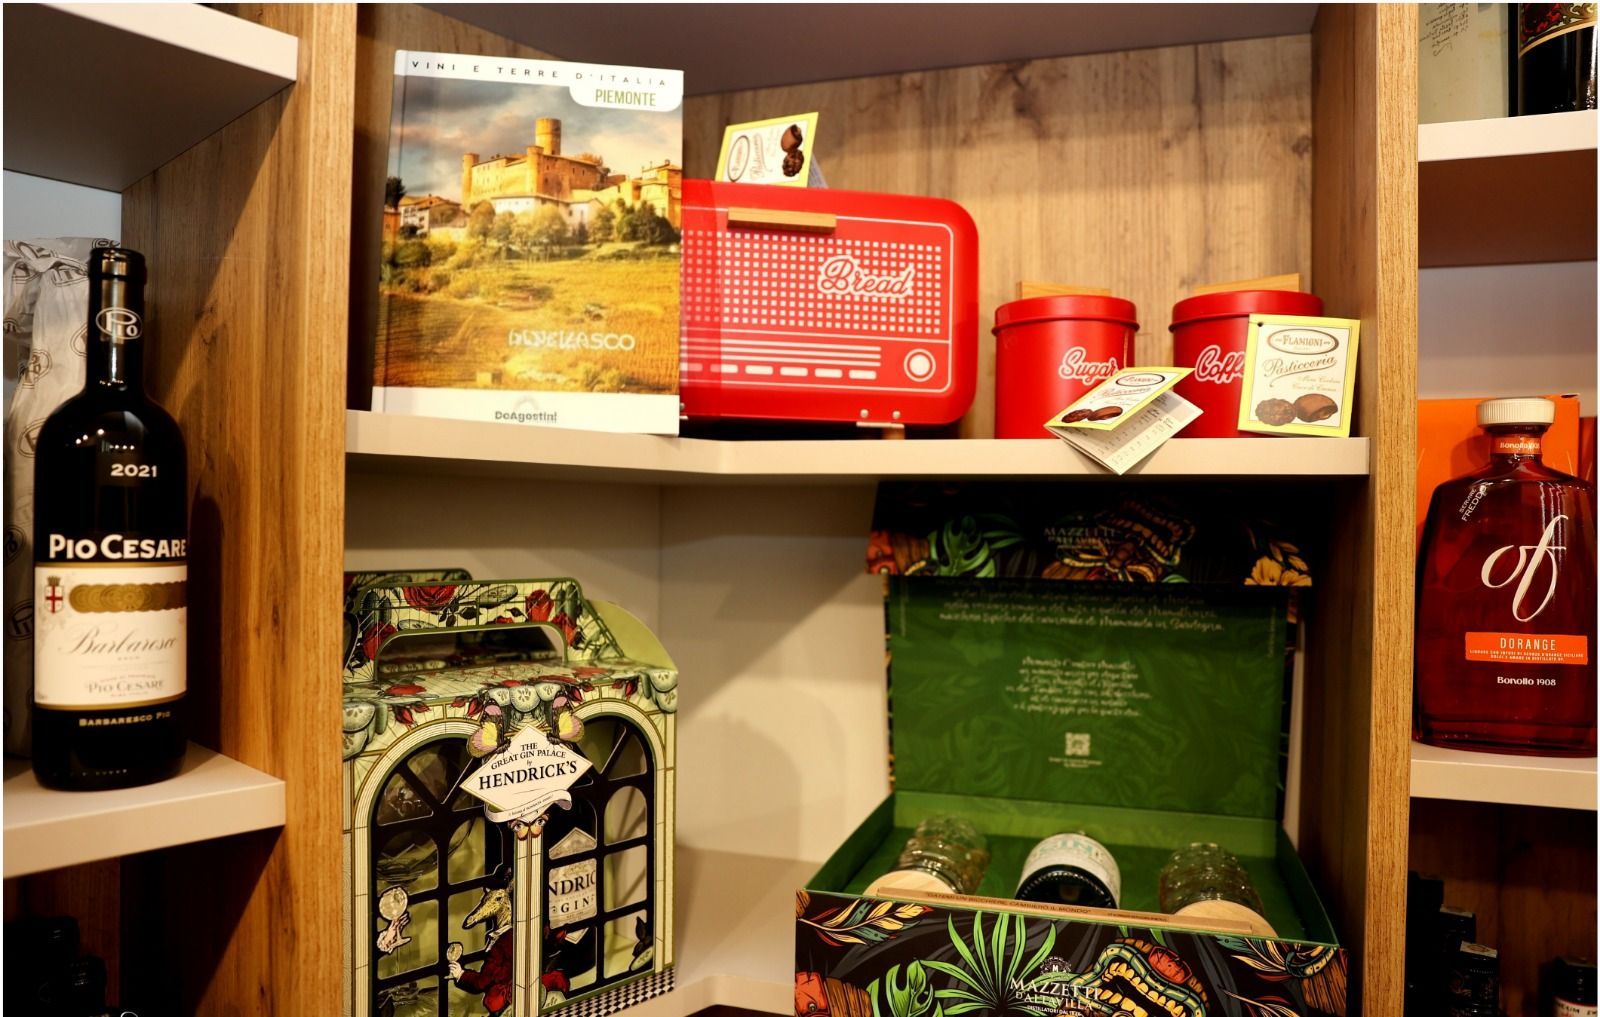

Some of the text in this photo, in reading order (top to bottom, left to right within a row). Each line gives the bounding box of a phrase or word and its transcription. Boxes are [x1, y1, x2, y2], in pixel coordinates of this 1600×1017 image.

[412, 61, 666, 86] VINI E TERRE D'ITALIA
[595, 89, 657, 107] PIEMONTE
[818, 255, 915, 298] Bread
[1059, 346, 1120, 385] Sugar
[1195, 345, 1246, 384] Coff
[1263, 354, 1337, 380] Pasticceria
[111, 464, 157, 477] 2021
[1459, 488, 1477, 513] SERVIRE
[1461, 484, 1487, 522] FREDDO
[100, 534, 186, 559] CESARE
[1500, 637, 1557, 650] DORANGE
[1497, 676, 1557, 686] Bonollo 1908
[79, 713, 153, 727] BARBARESCO
[521, 742, 538, 751] THE
[491, 749, 566, 769] GREAT GIN PALACE
[526, 759, 532, 767] by
[479, 760, 577, 790] HENDRICK'S
[561, 897, 589, 914] GIN
[1010, 977, 1098, 1000] MAZZETTI
[1015, 990, 1093, 1011] D'ALTAVILLA
